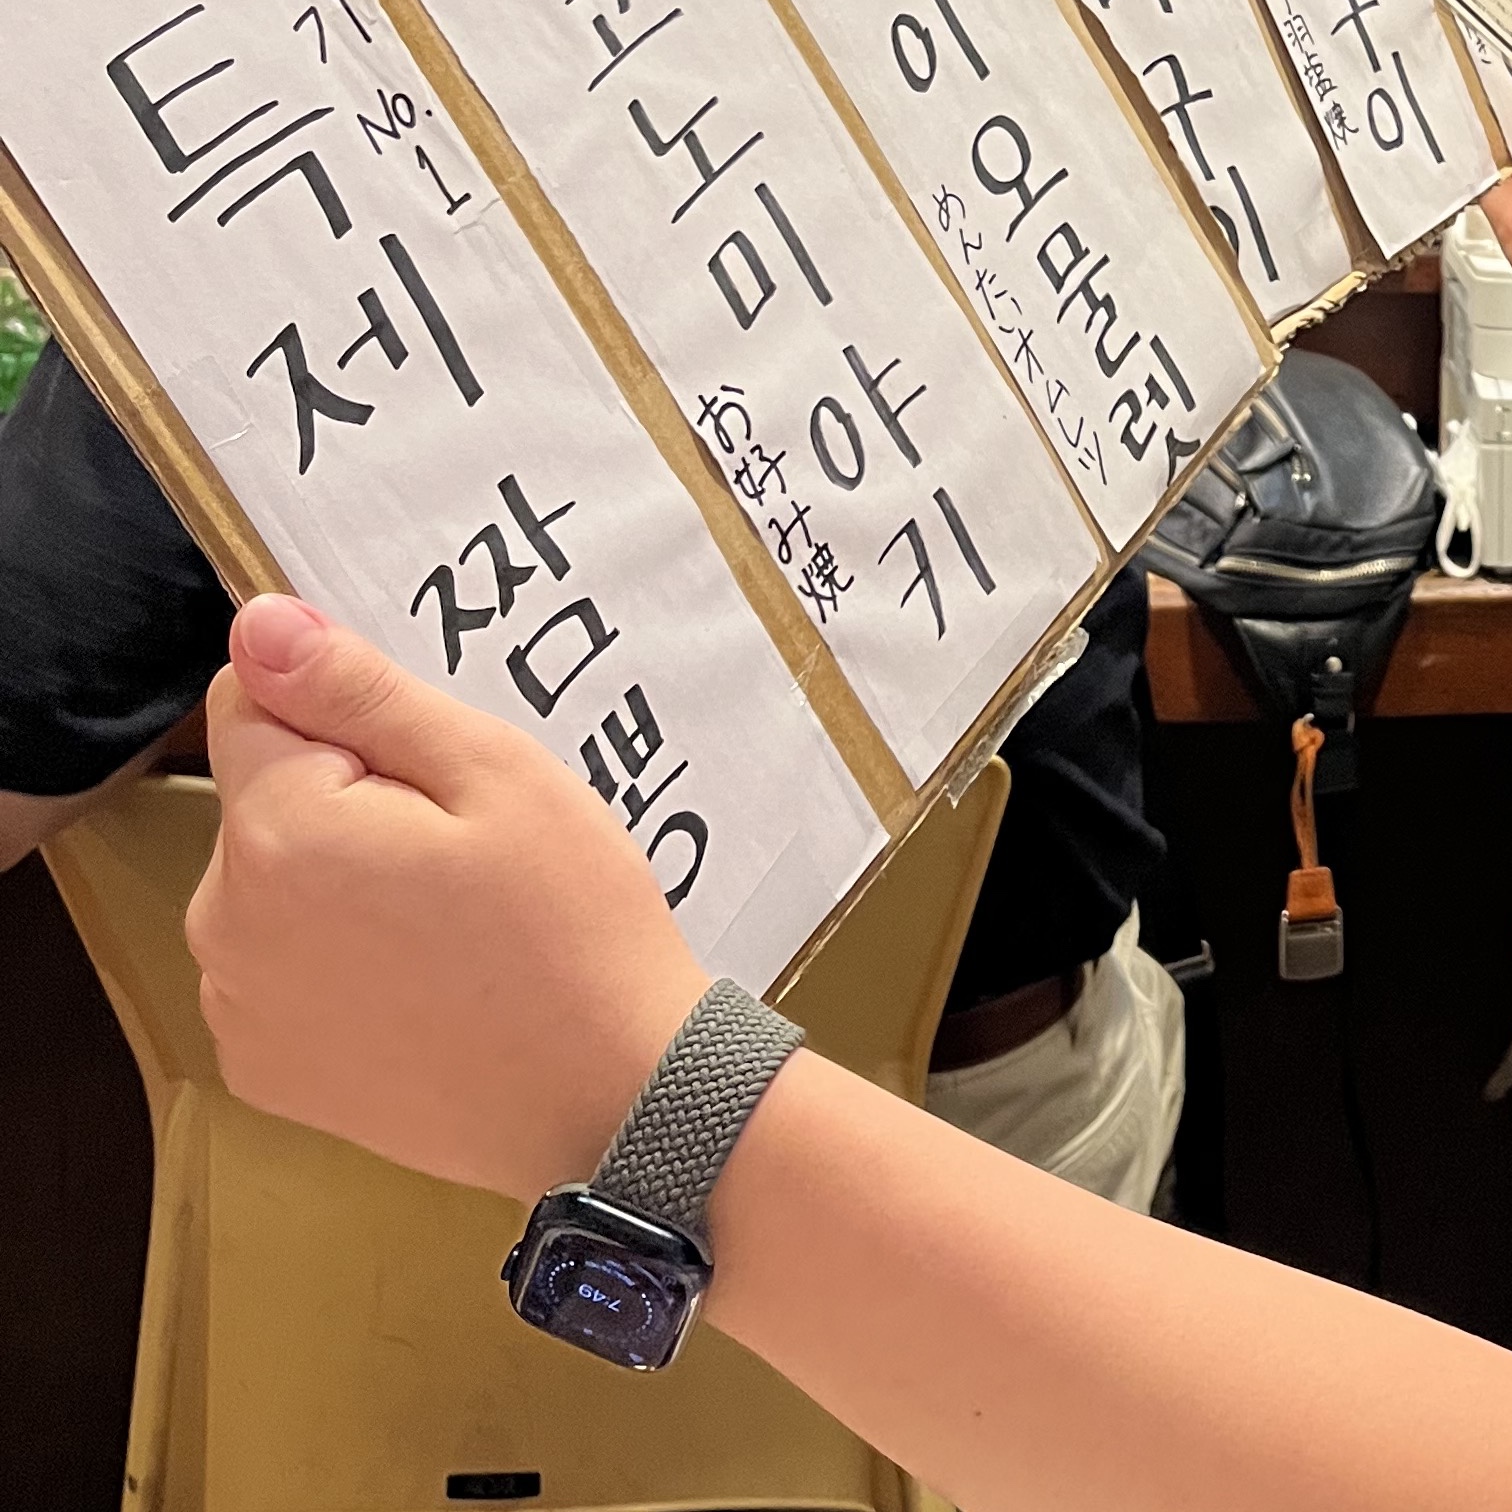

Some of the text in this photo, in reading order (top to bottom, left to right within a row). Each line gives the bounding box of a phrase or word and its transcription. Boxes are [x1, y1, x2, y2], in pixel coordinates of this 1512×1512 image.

[696, 384, 855, 624] お好み焼
[577, 1282, 623, 1313] 7:49
